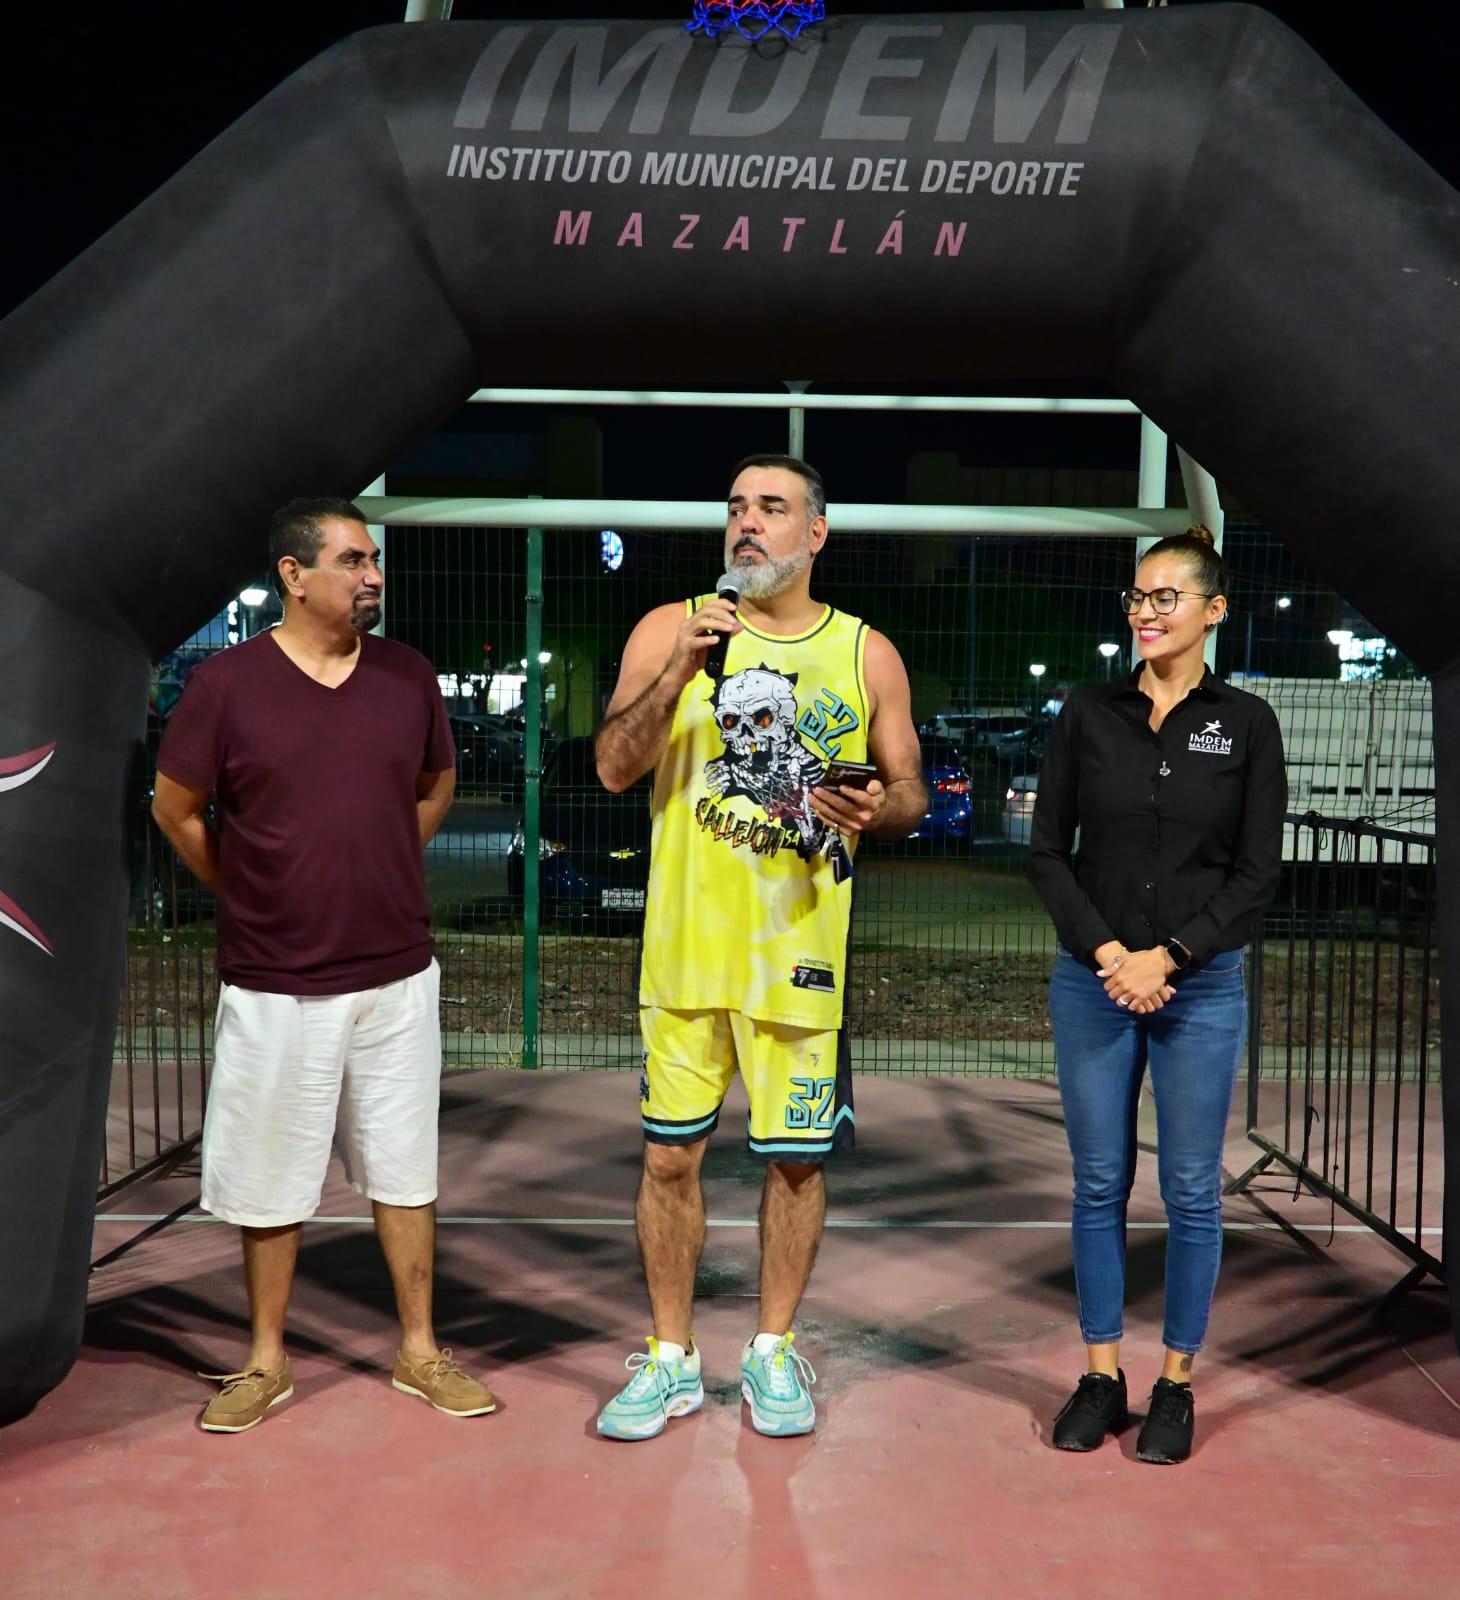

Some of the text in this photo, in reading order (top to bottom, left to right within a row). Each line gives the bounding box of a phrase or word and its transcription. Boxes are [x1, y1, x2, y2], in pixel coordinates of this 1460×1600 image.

[453, 24, 1124, 144] IMDEM
[446, 144, 1084, 196] INSTITUTO MUNICIPAL DEL DEPORTE
[553, 209, 967, 257] MAZATLÁN
[1189, 733, 1233, 747] IMDEM
